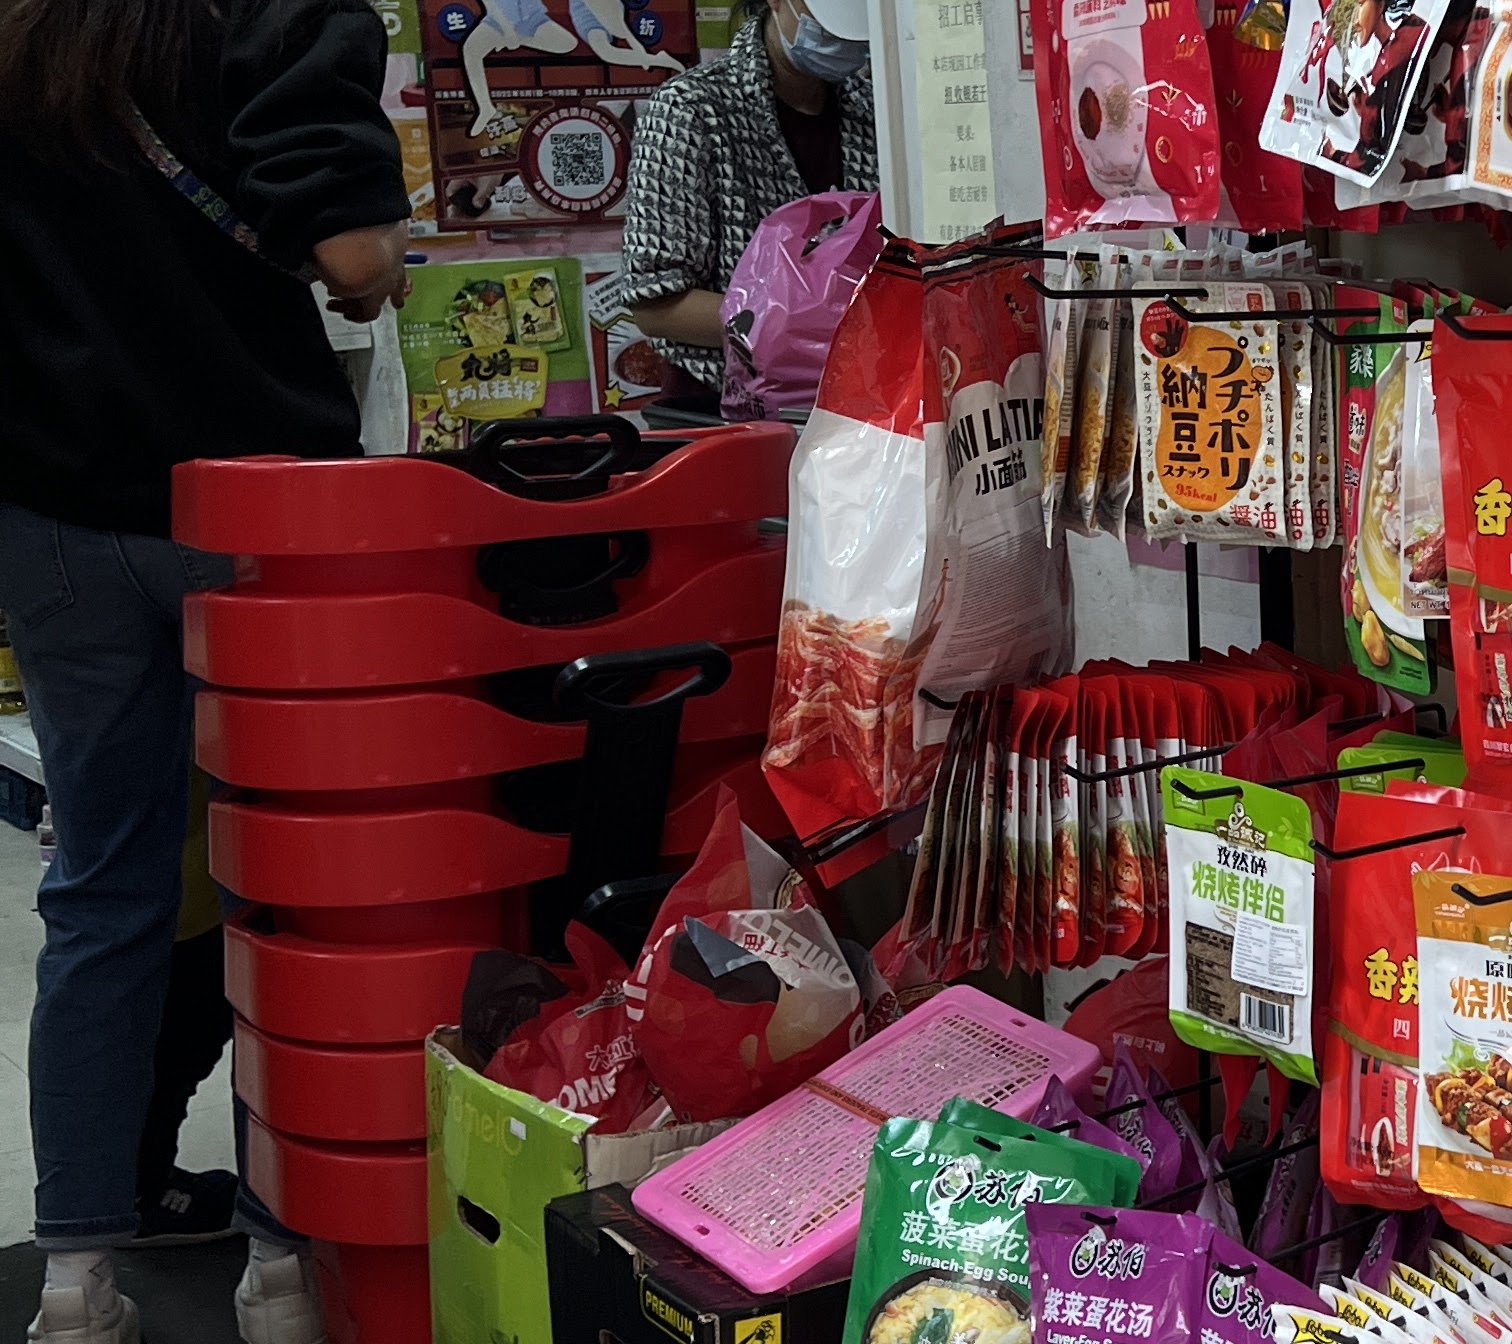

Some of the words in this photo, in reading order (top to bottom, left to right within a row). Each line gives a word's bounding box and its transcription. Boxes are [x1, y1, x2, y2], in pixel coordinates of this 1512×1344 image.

[986, 397, 1046, 451] LATIA
[1160, 362, 1208, 464] 納豆
[1206, 334, 1251, 492] プチポリ
[1162, 463, 1211, 480] スナック
[1216, 845, 1268, 878] 孜然碎
[1191, 861, 1286, 923] 烧烤伴侣
[898, 1208, 1031, 1267] 菠菜蛋花
[900, 1248, 994, 1282] Spinach-Egg
[644, 1290, 695, 1344] PREMIUM
[1040, 1287, 1155, 1339] 紫菜蛋花汤
